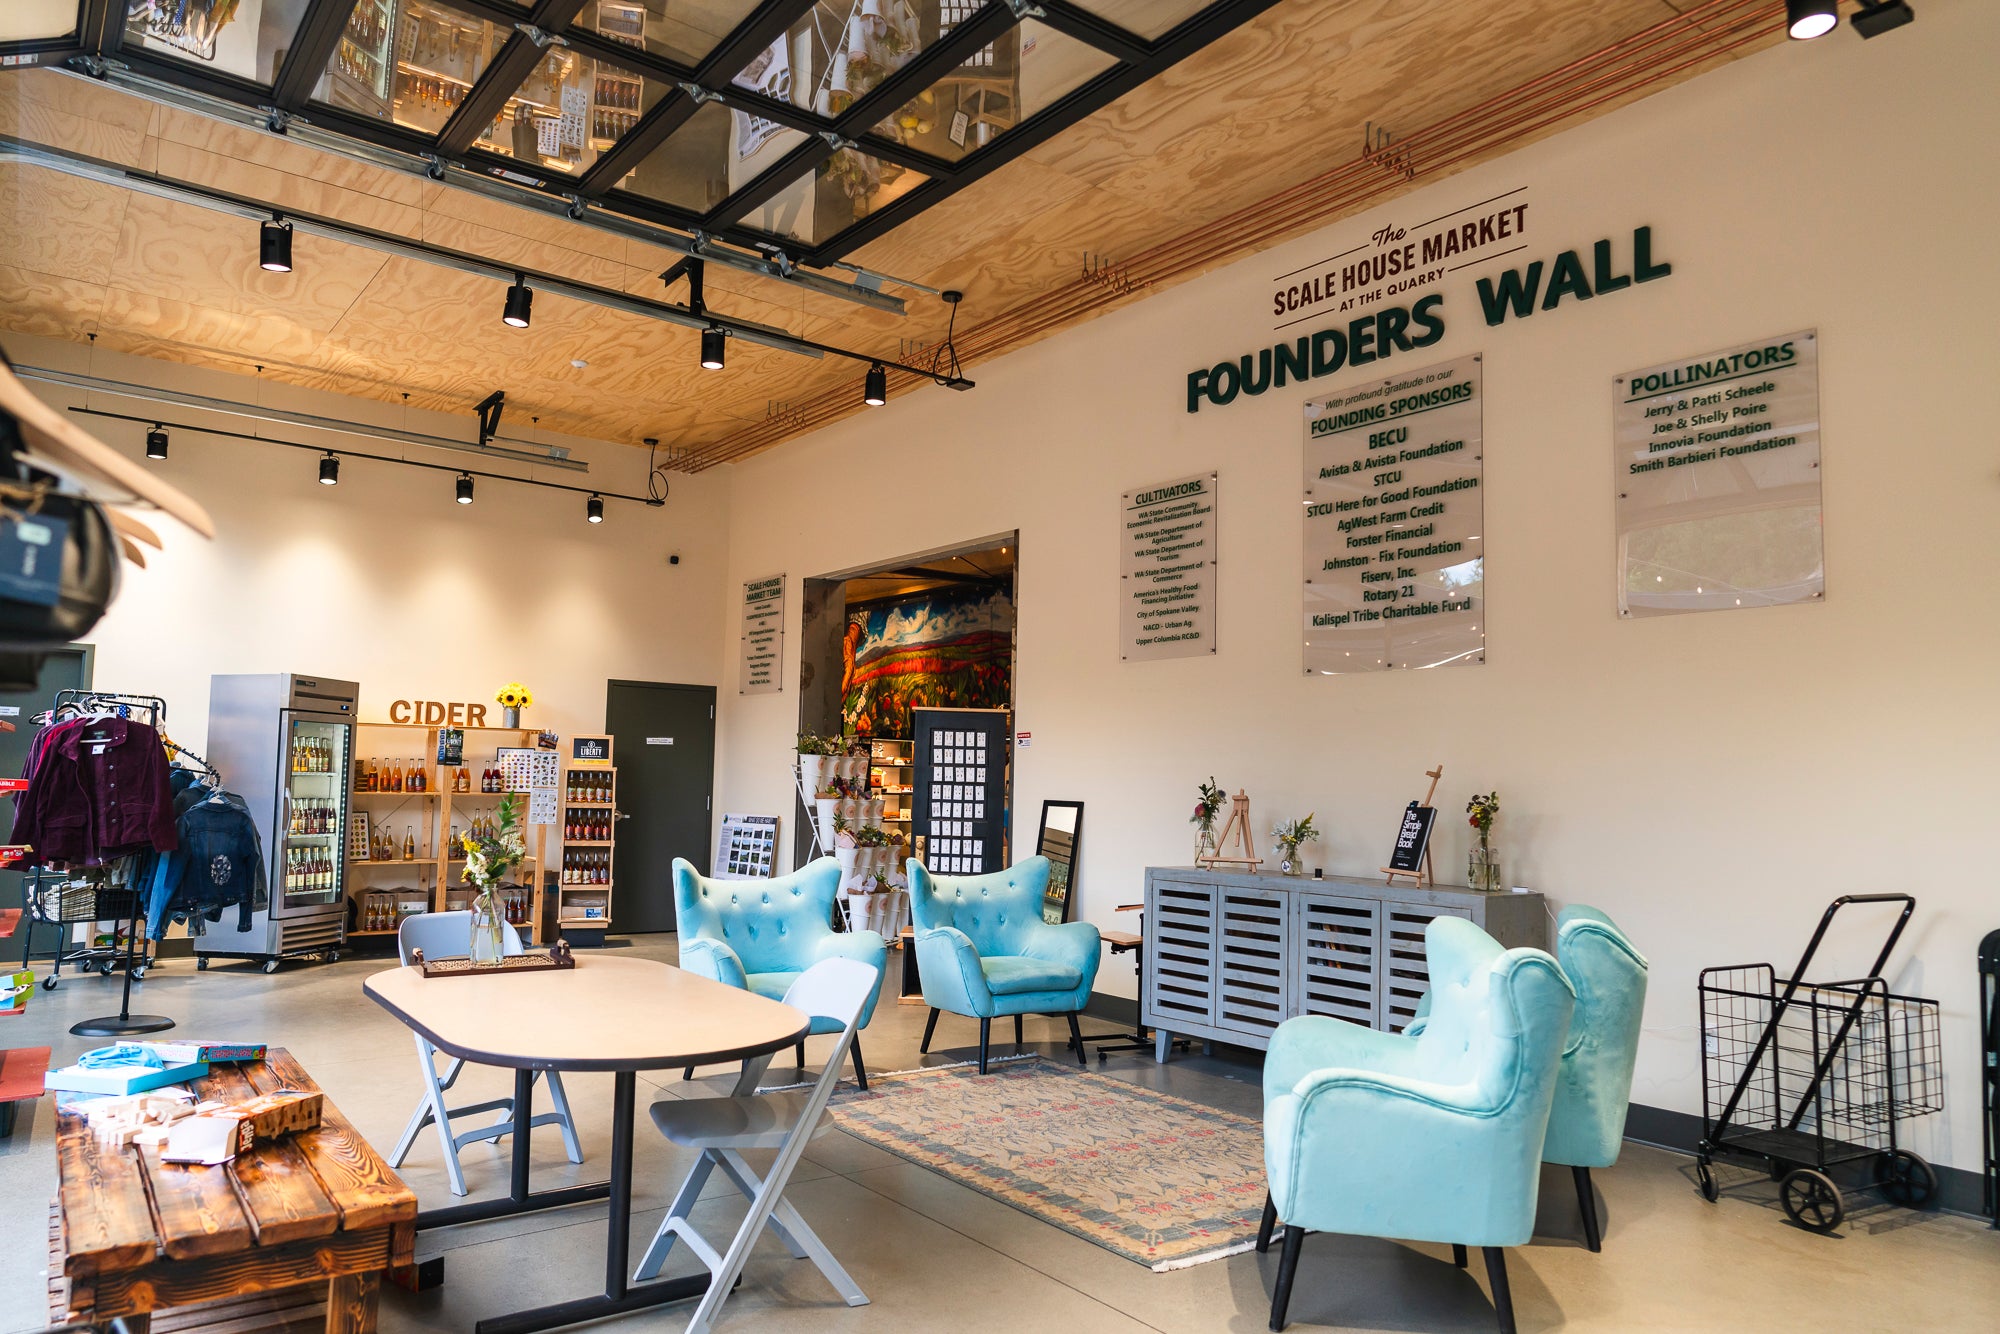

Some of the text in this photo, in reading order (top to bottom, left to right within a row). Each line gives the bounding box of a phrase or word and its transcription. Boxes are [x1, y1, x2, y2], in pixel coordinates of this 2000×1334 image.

[1372, 223, 1407, 248] The
[1273, 203, 1528, 317] SCALE HOUSE MARKET
[1339, 267, 1446, 313] AT THE QUARRY
[1186, 225, 1672, 414] FOUNDERS WALL
[1631, 342, 1795, 395] POLLINATORS
[1325, 369, 1453, 410] With profound gratitude to our
[1311, 382, 1472, 434] FOUNDING SPONSORS
[1645, 382, 1775, 418] Jerry & Patti Scheele
[1653, 403, 1767, 434] Joe & Shelly Poire
[1369, 427, 1407, 449] BECU
[1649, 421, 1772, 453] Innovia Foundation
[1319, 439, 1463, 479] Avista & Avista Foundation
[1630, 436, 1796, 474] Smith Barbieri Foundation
[1374, 471, 1402, 486] STCU
[1135, 480, 1202, 505] CULTIVATORS
[1307, 476, 1477, 517] STCU Here for Good Foundation
[1127, 506, 1210, 529] Economic Revitalization Board
[1138, 502, 1198, 519] WA State Community
[1337, 502, 1444, 533] AgWest Farm Credit
[1134, 521, 1202, 540] WA State Department of
[1152, 534, 1183, 545] Agriculture
[1347, 523, 1433, 548] Forster Financial
[1135, 540, 1203, 558] WA State Department of
[1156, 553, 1179, 562] Tourism
[1322, 554, 1368, 571] Johnston
[1379, 549, 1394, 562] Fix
[1397, 540, 1461, 560] Foundation
[1135, 561, 1203, 578] WA State Department of
[1152, 574, 1182, 583] Commerce
[1397, 567, 1417, 579] Inc.
[747, 588, 780, 601] MARKET TEAM
[748, 578, 780, 592] SCALE HOUSE
[1160, 586, 1182, 596] Healthy
[1184, 584, 1198, 592] Food
[1363, 585, 1414, 602] Rotary 21
[1141, 593, 1194, 606] Financing Initiative
[1137, 611, 1148, 619] City
[1156, 607, 1180, 617] Spokane
[1181, 605, 1199, 614] Valley
[1312, 597, 1470, 628] Kalispel Tribe Charitable Fund
[1184, 620, 1192, 628] Ag
[1136, 638, 1153, 646] Upper
[1154, 635, 1180, 643] Columbia
[390, 700, 487, 727] CIDER
[1406, 810, 1416, 820] The
[1400, 829, 1418, 839] Bread
[1403, 820, 1421, 831] Simple
[1398, 838, 1413, 848] Book
